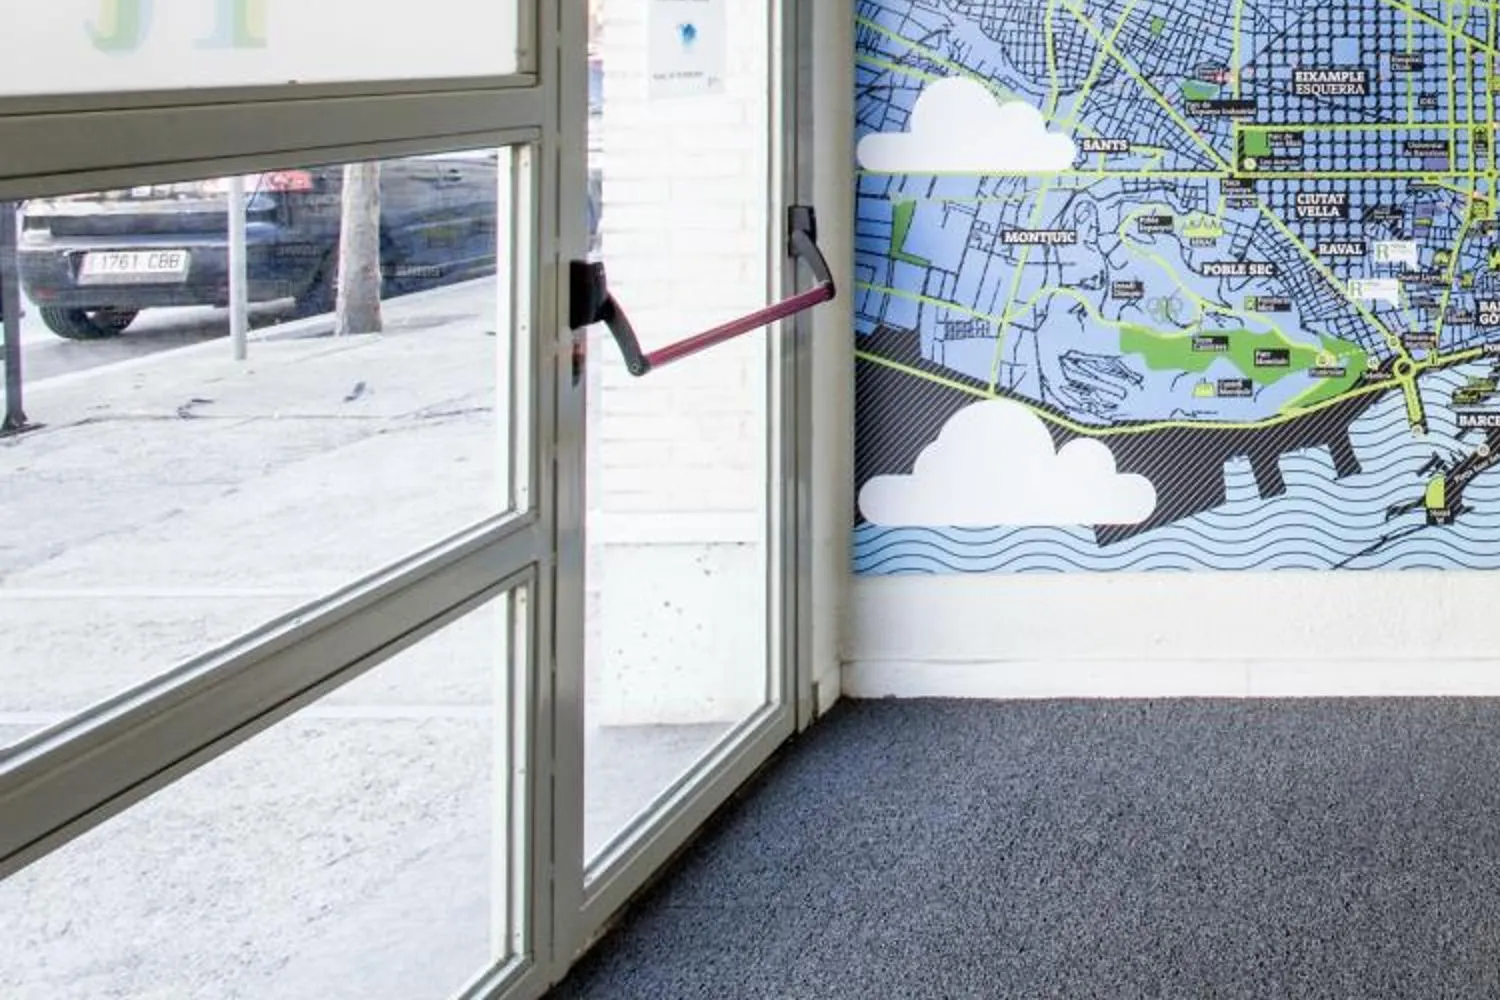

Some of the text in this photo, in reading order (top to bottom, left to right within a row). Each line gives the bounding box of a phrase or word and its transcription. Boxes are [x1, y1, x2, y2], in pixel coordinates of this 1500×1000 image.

[1295, 71, 1366, 83] EIXAMPLE
[1295, 83, 1366, 96] ESQUERRA
[1083, 139, 1128, 150] SANTS
[1297, 193, 1346, 205] CIUTAT
[1297, 205, 1340, 217] VELLA
[1318, 243, 1363, 255] RAVAL
[99, 253, 138, 270] 1761
[1203, 263, 1274, 275] POBLE SEC
